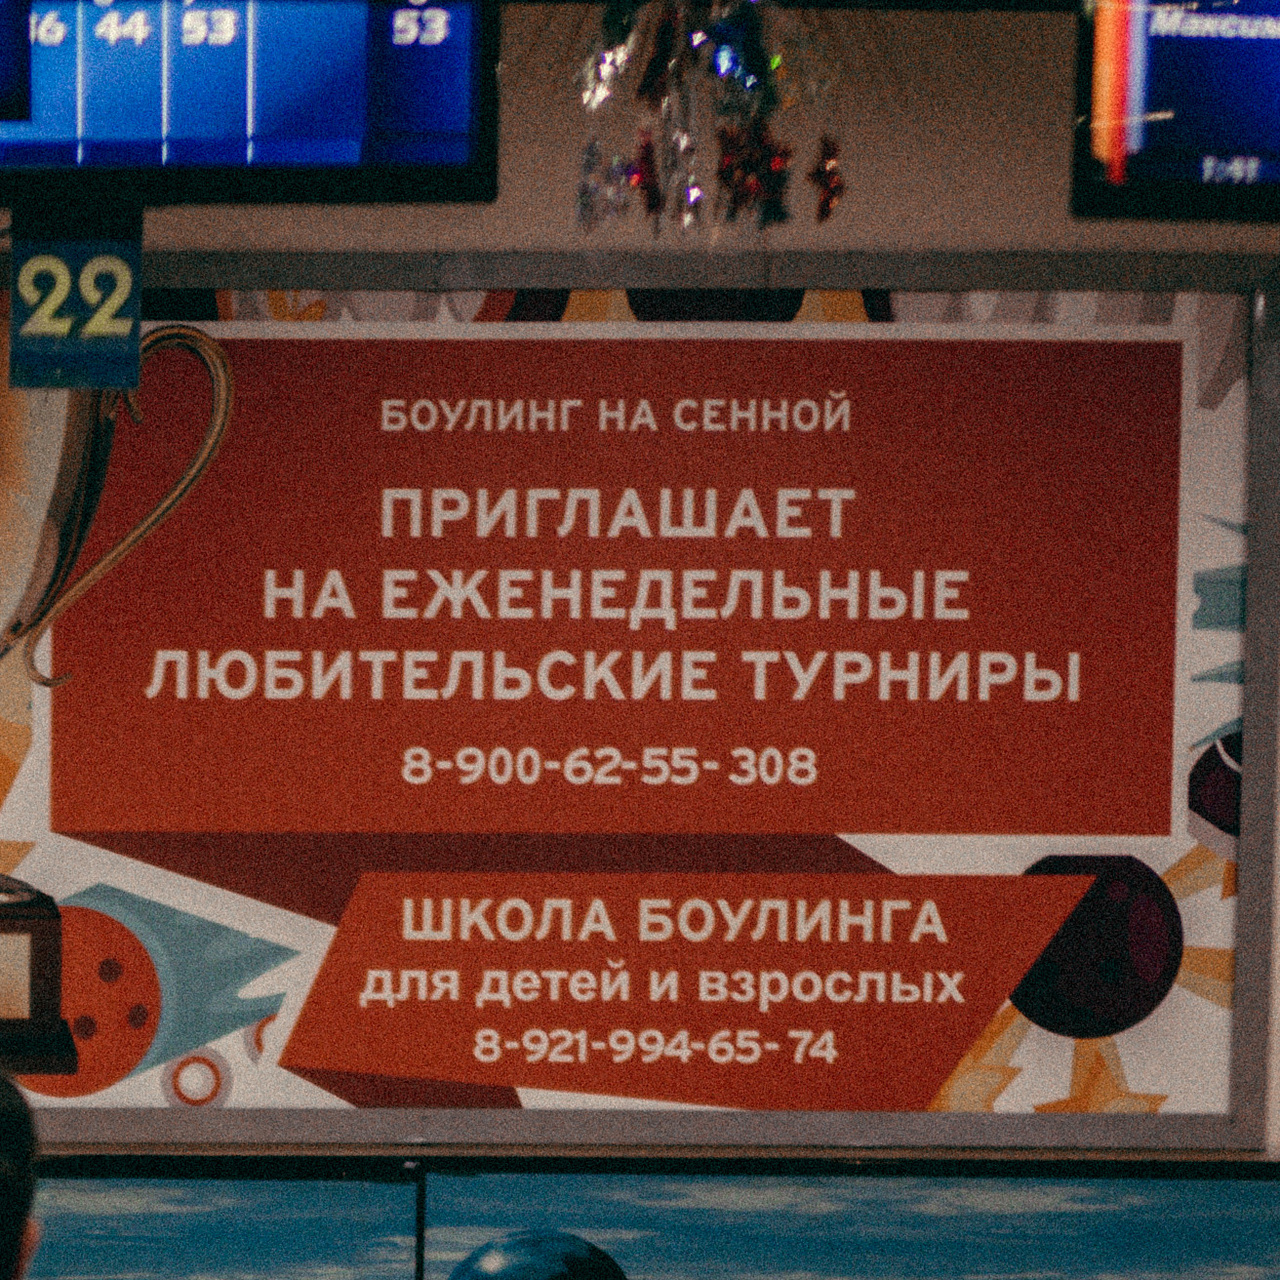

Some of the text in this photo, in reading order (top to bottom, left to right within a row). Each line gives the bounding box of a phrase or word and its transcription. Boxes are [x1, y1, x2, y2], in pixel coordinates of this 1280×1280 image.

[93, 10, 151, 46] 44
[180, 9, 239, 46] 53
[391, 9, 449, 46] 53
[16, 253, 134, 339] 22
[380, 390, 852, 434] БОУЛИНГ НА СЕННОЙ
[380, 487, 857, 540] ПРИГЛАШАЕТ
[263, 568, 970, 632] НА ЕЖЕНЕДЕЛЬНЫЕ
[144, 648, 1081, 703] ЛЮБИТЕЛЬСКИЕ ТУРНИРЫ
[401, 896, 949, 944] ШКОЛА БОУЛИНГА
[357, 959, 965, 1014] для детей и взрослых
